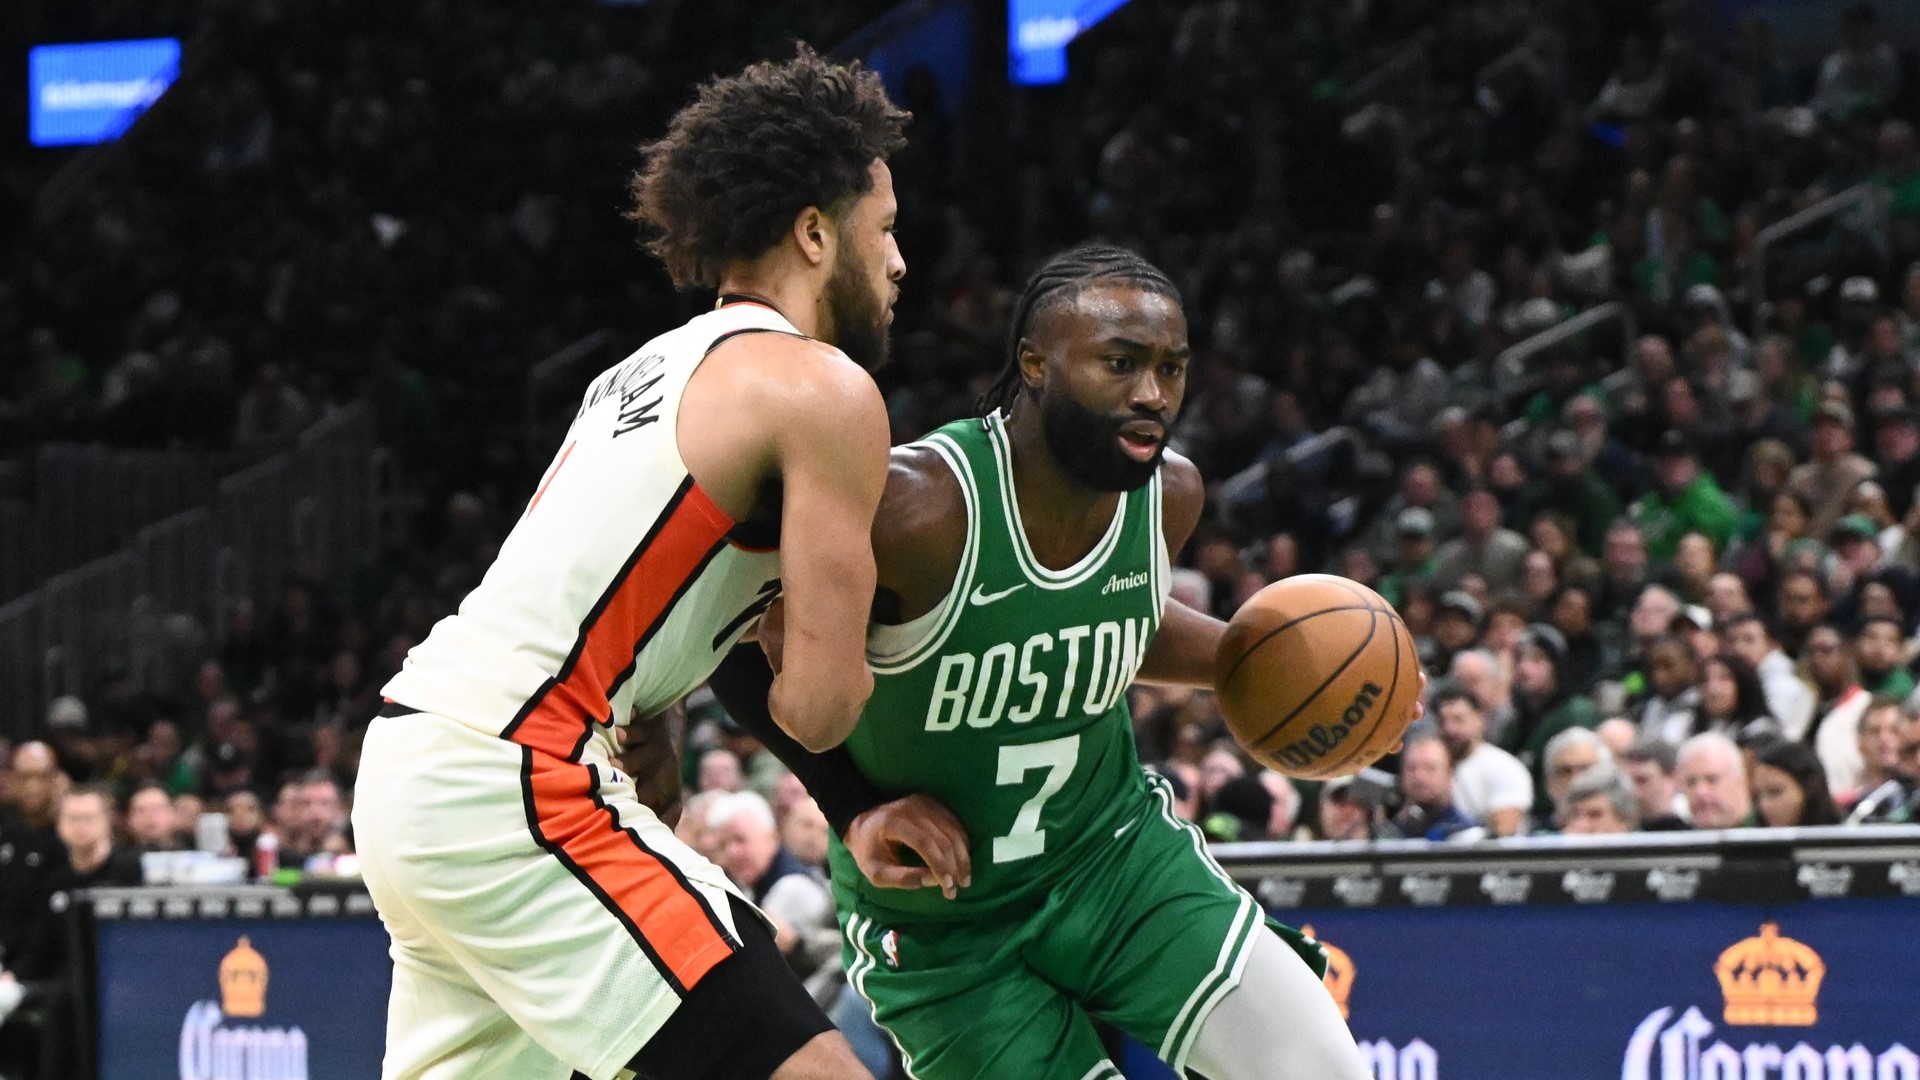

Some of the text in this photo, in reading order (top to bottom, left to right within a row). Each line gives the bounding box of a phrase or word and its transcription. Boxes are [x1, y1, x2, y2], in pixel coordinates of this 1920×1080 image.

[1101, 571, 1148, 595] Amica
[924, 617, 1149, 732] BOSTON
[1270, 681, 1384, 769] Wilson
[992, 733, 1081, 865] 7
